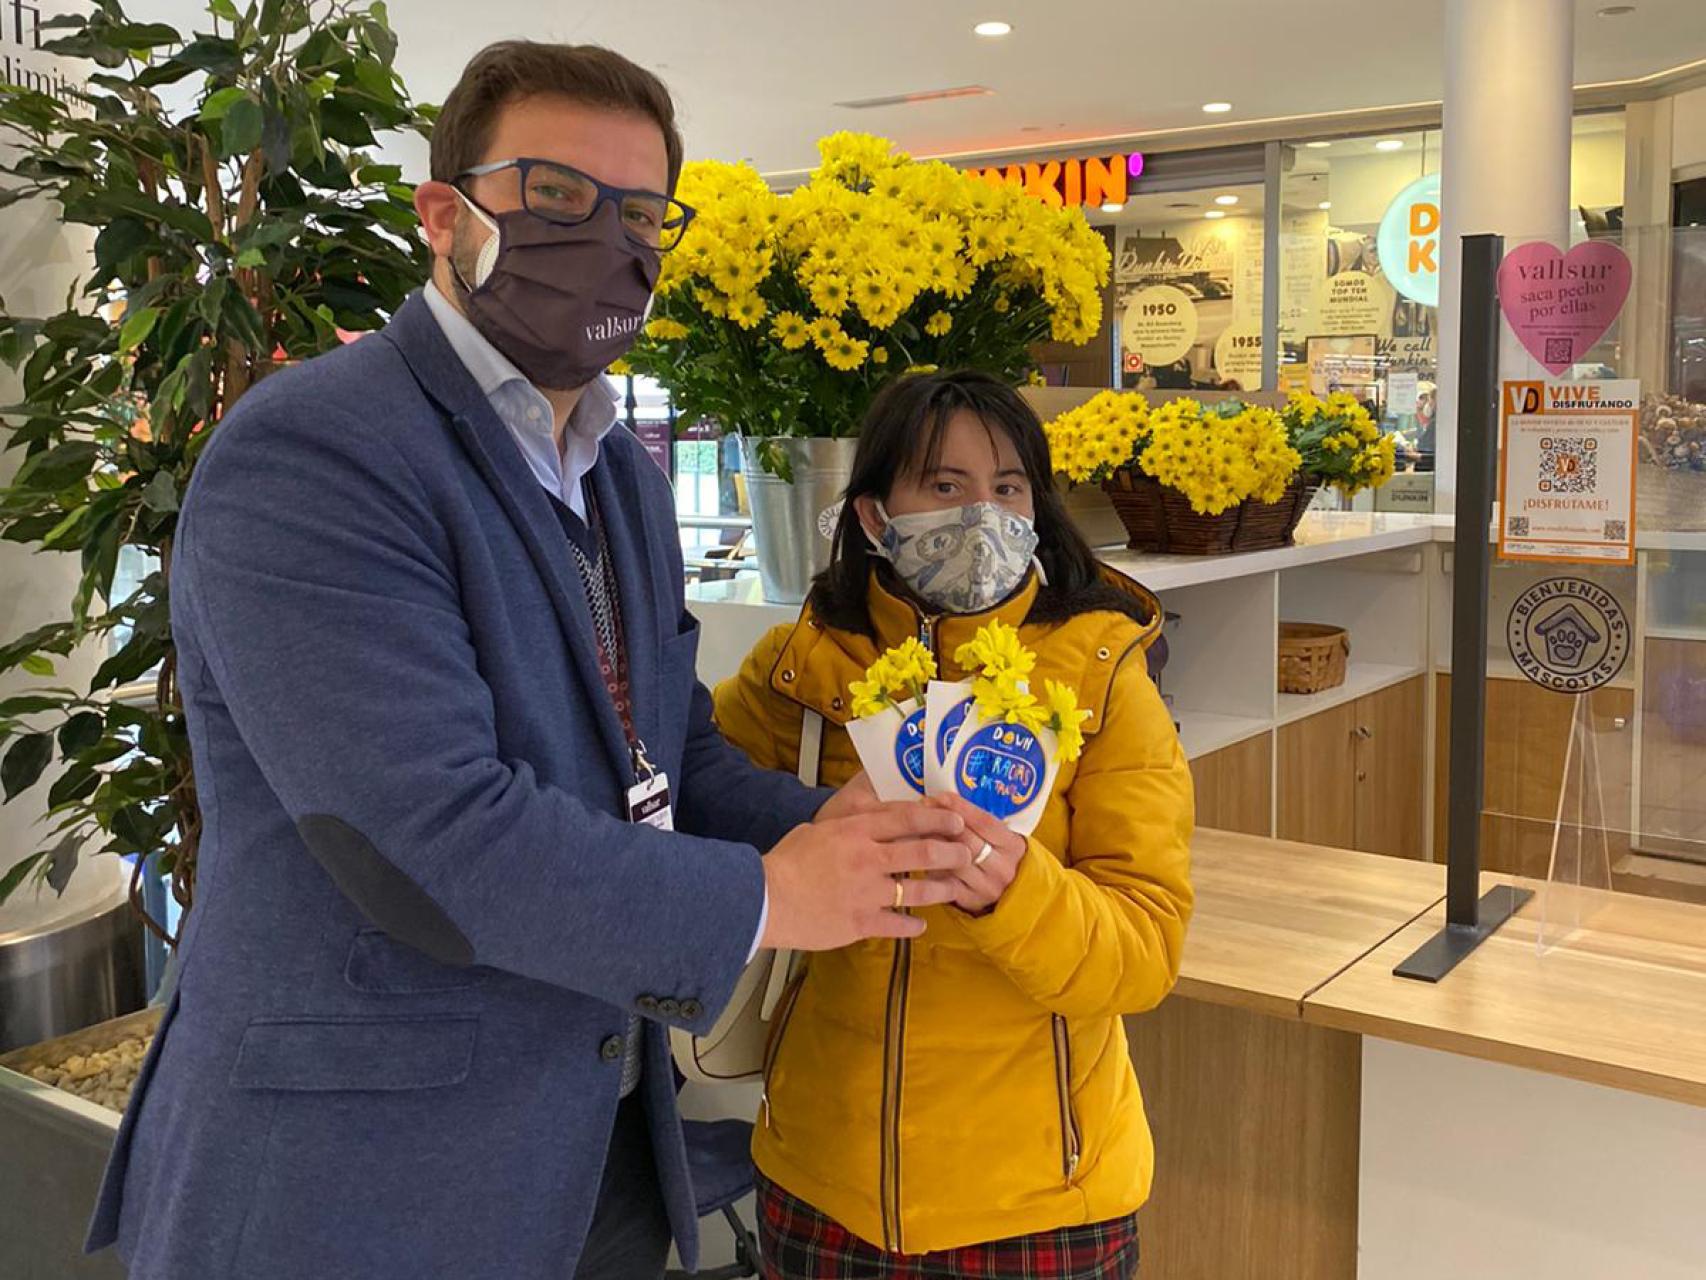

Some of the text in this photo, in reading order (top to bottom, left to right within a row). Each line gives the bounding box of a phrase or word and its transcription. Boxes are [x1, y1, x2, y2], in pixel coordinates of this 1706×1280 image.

[1519, 260, 1613, 280] vallsur
[1520, 282, 1606, 304] saca pecho
[1142, 303, 1177, 316] 1950
[1530, 299, 1596, 322] por ellas
[1231, 337, 1262, 347] 1955
[1549, 386, 1600, 401] VIVE
[1552, 400, 1633, 408] DISFRUTANDO
[1516, 581, 1624, 631] BIENVENIDAS
[1517, 652, 1613, 689] MASCOTAS
